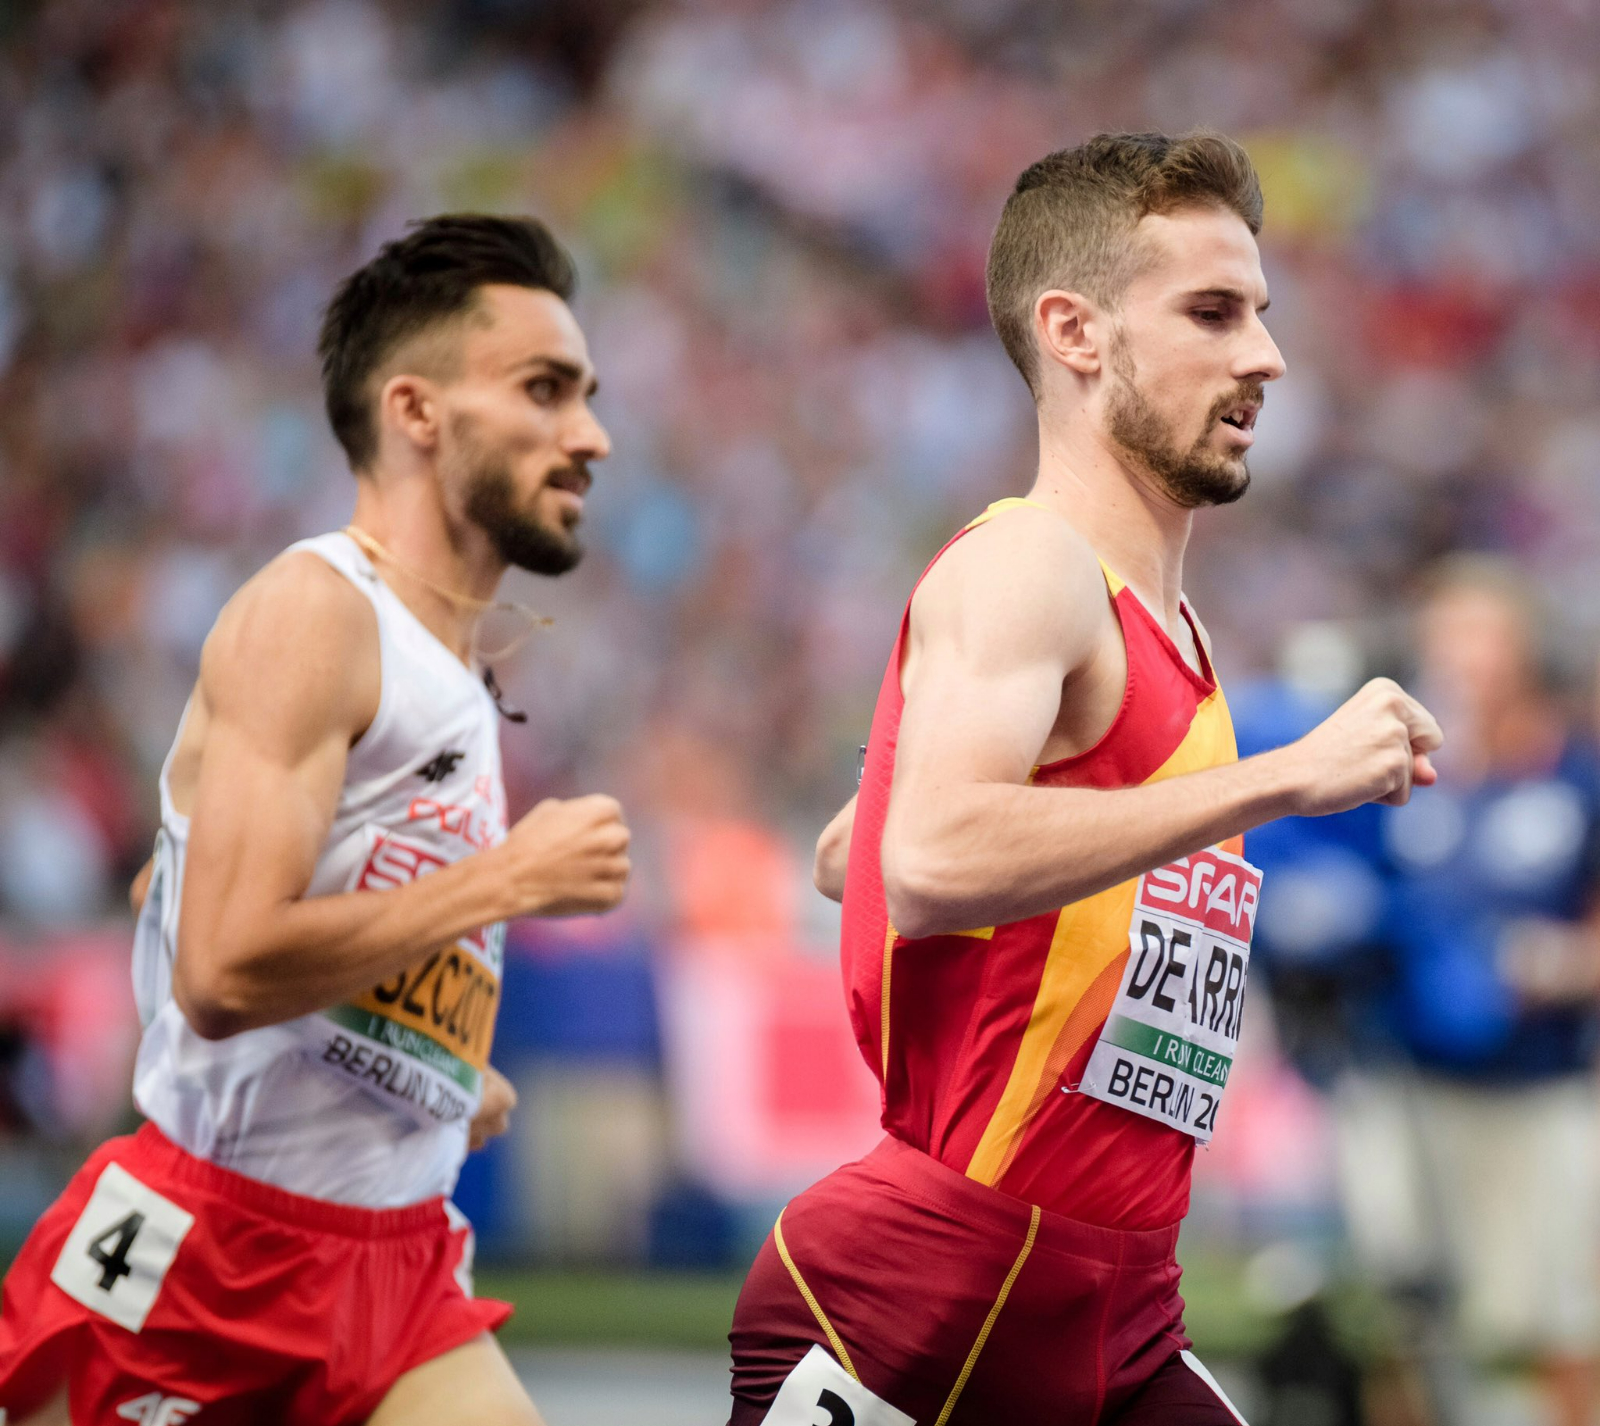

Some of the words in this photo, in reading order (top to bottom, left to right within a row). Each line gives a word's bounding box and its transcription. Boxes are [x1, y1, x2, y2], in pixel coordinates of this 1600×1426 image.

[1126, 920, 1191, 1013] DE
[322, 1035, 430, 1109] BERLIN
[1153, 1035, 1163, 1055] I
[1107, 1058, 1195, 1123] BERLIN
[87, 1210, 145, 1293] 4
